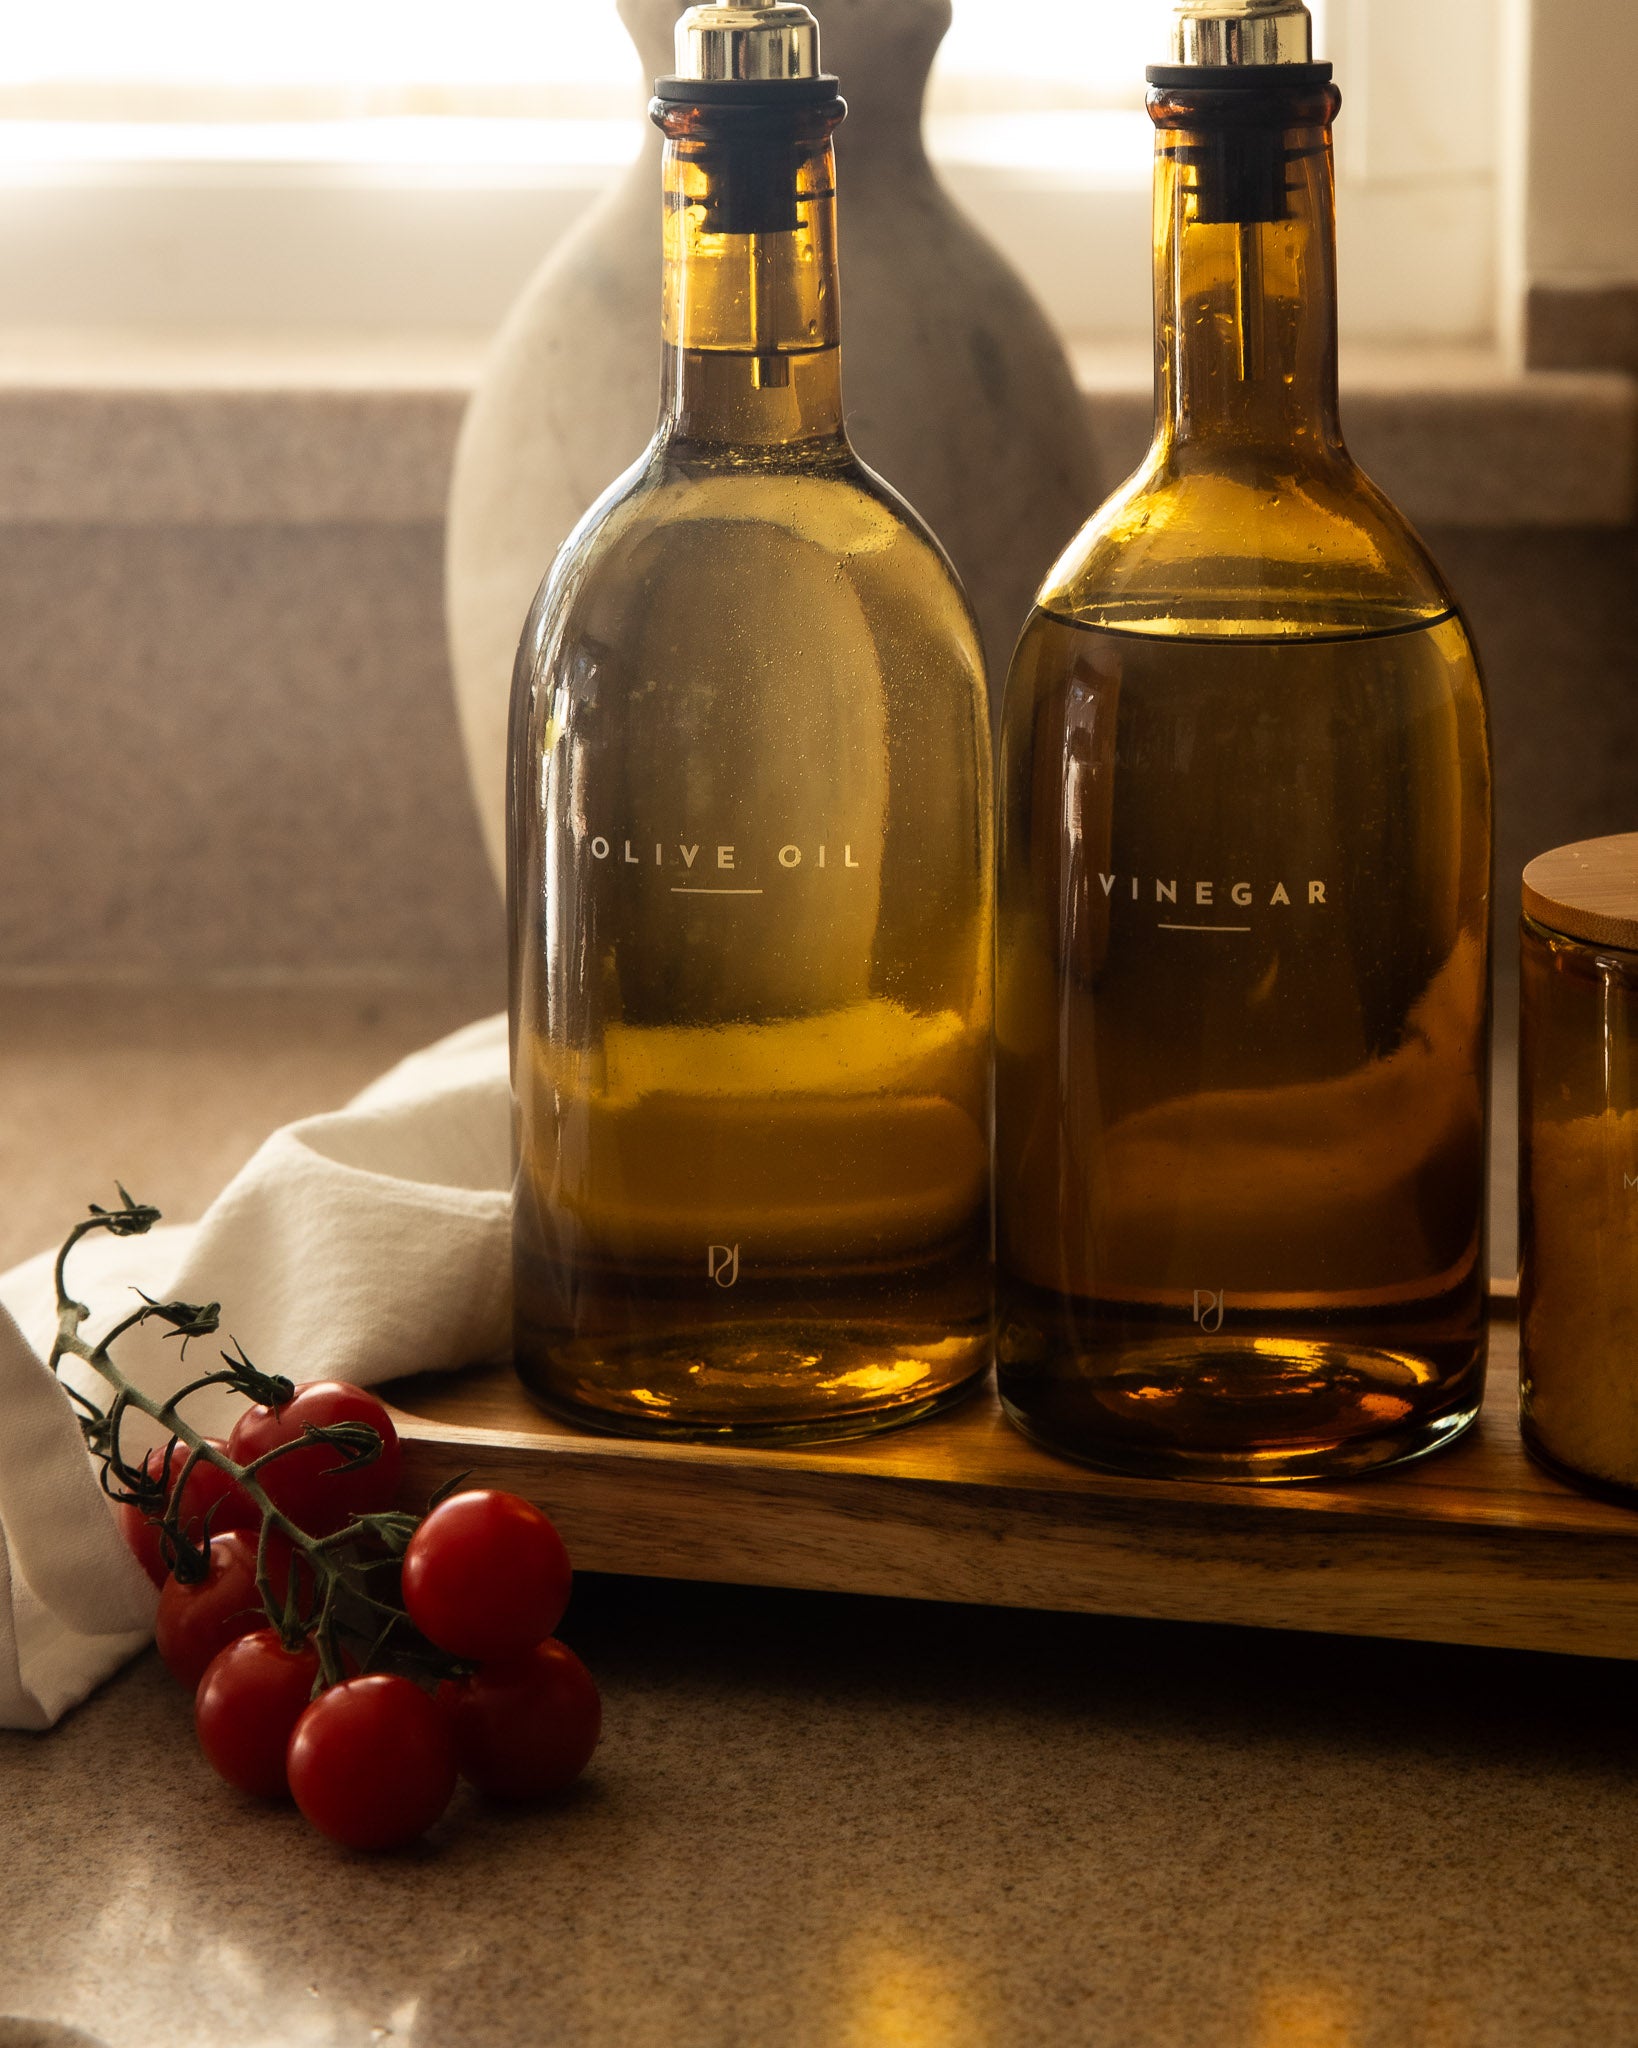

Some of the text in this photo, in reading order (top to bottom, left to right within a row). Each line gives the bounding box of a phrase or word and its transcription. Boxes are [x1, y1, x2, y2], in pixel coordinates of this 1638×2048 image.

[591, 836, 859, 869] OLIVE OIL
[1098, 873, 1327, 906] VINEGAR
